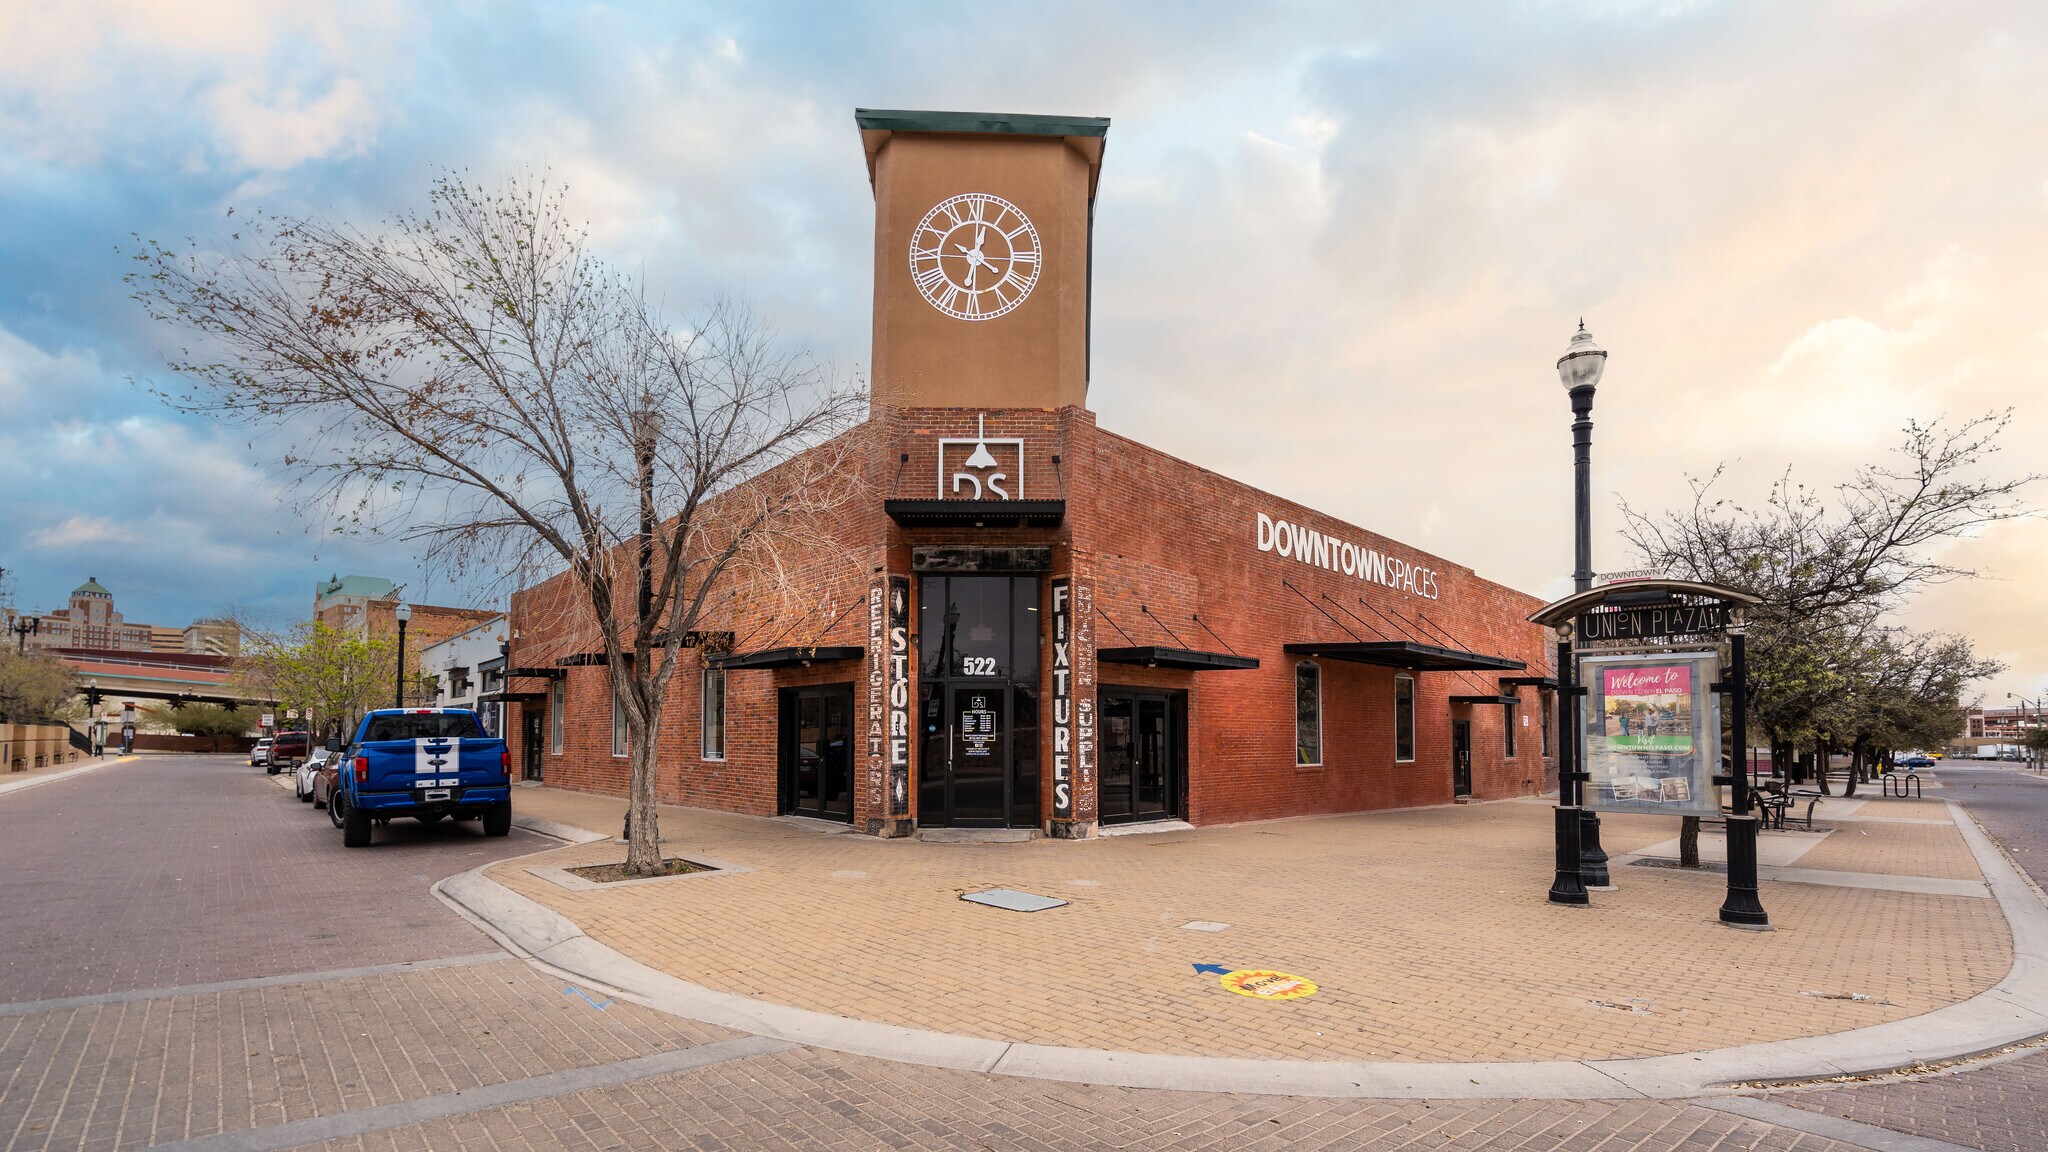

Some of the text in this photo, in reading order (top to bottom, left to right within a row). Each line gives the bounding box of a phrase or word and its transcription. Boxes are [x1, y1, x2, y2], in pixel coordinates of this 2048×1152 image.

[1601, 569, 1660, 580] DOWNTOWN
[1585, 607, 1709, 638] UNION PLAZA
[963, 656, 996, 676] 522
[1611, 668, 1678, 689] Welcome to
[891, 626, 908, 765] STORE
[1053, 585, 1071, 809] FIXTURES
[1637, 734, 1656, 745] Visit
